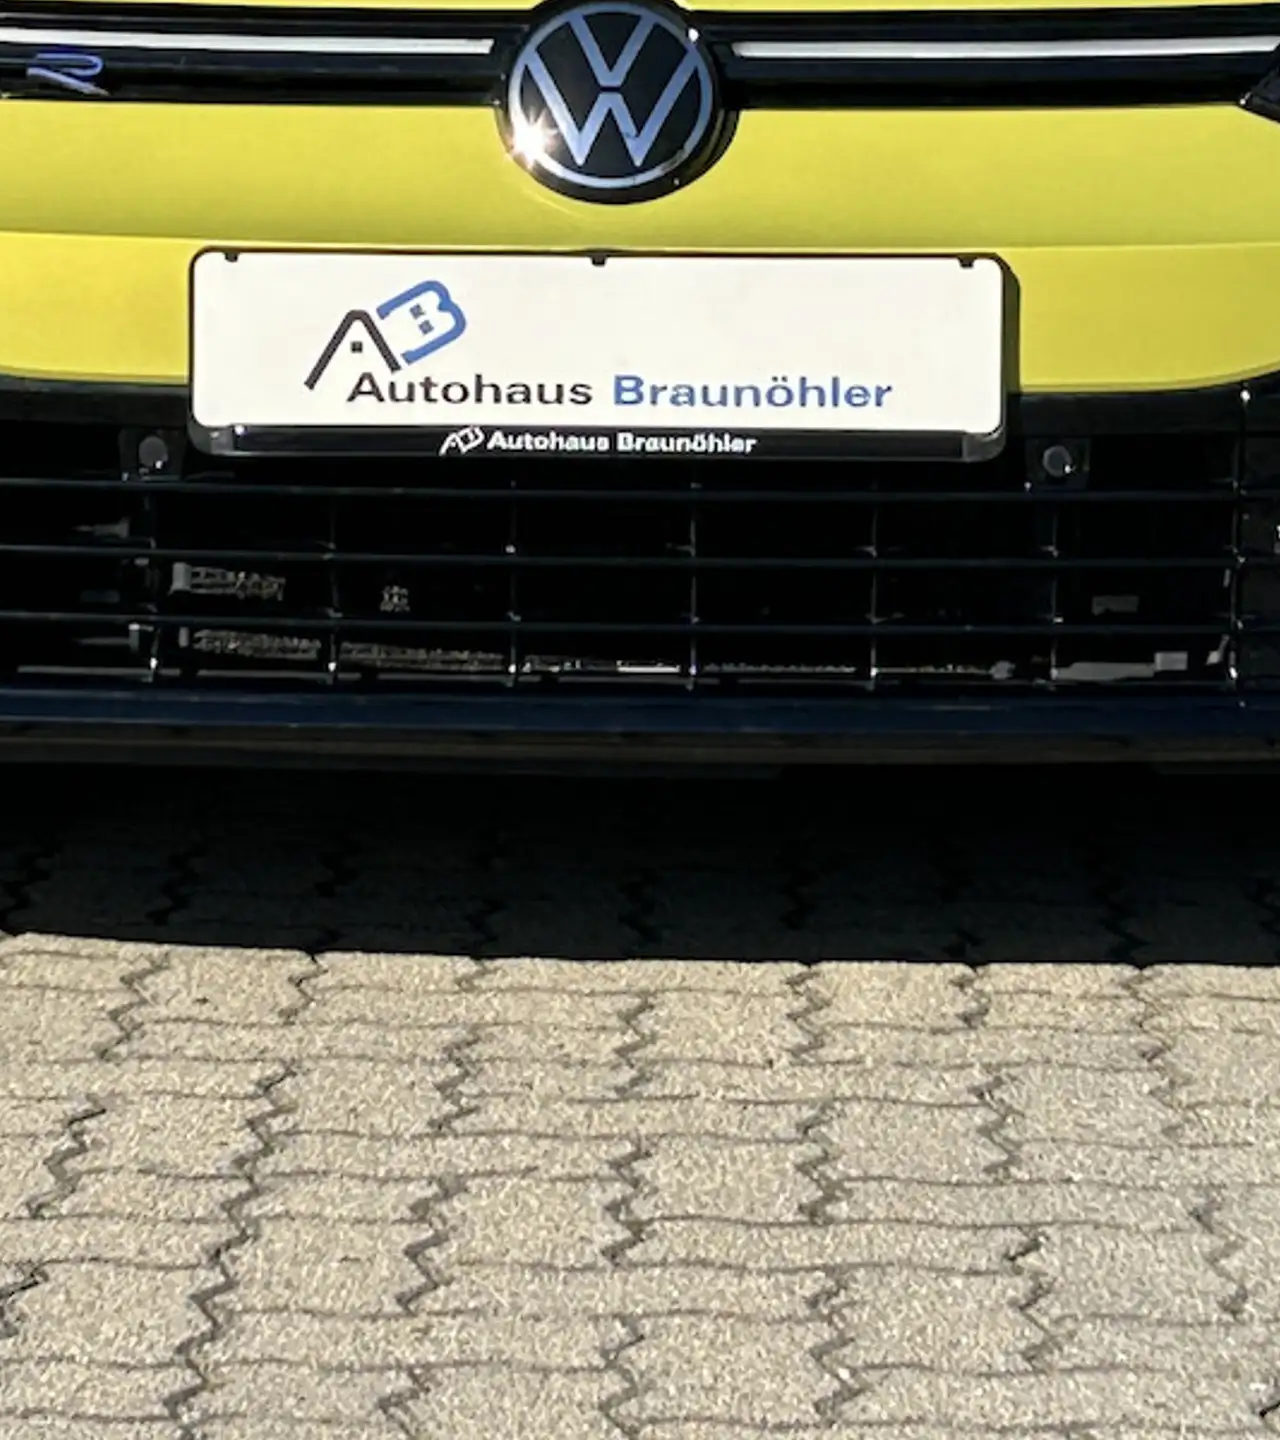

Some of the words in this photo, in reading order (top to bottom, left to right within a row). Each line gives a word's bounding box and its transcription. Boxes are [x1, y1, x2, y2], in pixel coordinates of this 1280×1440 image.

[346, 371, 593, 406] Autohaus
[613, 374, 893, 409] Braunöhler
[486, 430, 611, 452] Autohaus
[616, 431, 758, 454] Braunöhler
